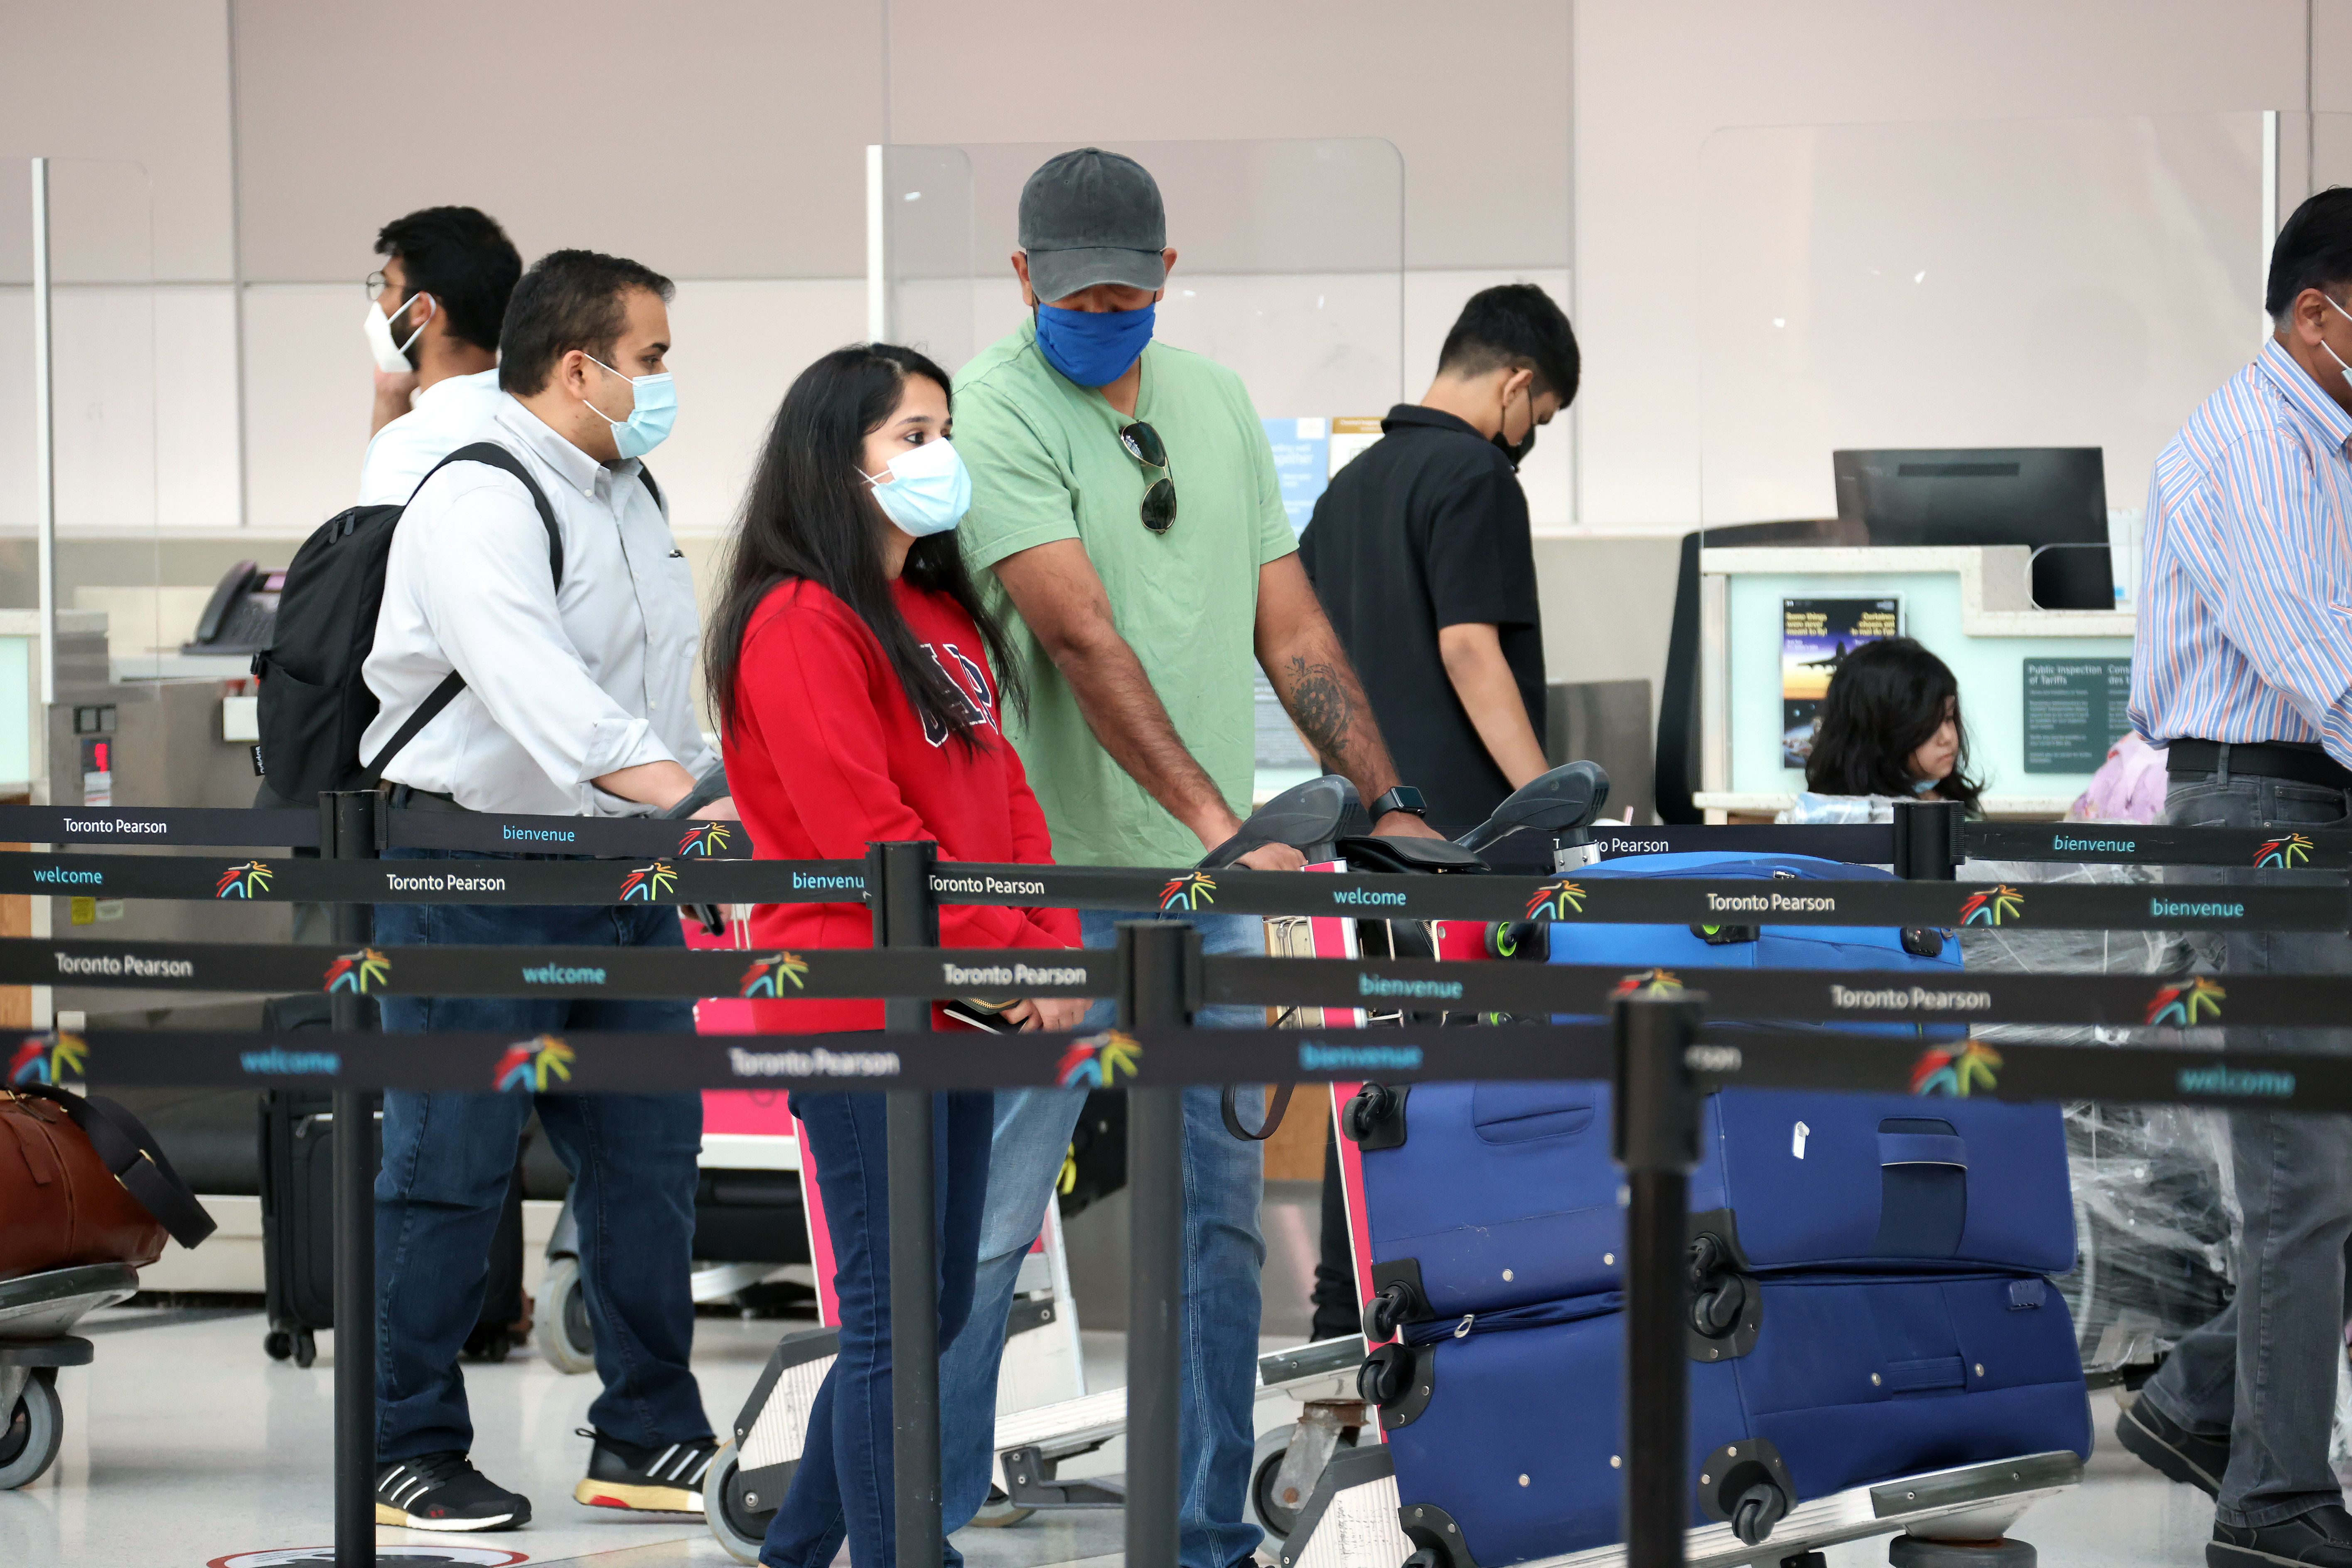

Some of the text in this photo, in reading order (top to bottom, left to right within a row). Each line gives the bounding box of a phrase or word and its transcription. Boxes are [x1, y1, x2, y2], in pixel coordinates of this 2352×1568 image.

[2029, 665, 2102, 675] Public Inspection
[2029, 675, 2067, 685] of Tariffs
[64, 818, 167, 833] Toronto Pearson
[504, 825, 575, 842] bienvenue
[1612, 838, 1669, 852] Pearson
[2054, 835, 2135, 852] bienvenue
[34, 866, 103, 884] welcome
[386, 874, 505, 890] Toronto Pearson
[793, 872, 864, 889] bienvenu
[929, 875, 1044, 894] Toronto Pearson
[1334, 887, 1406, 905] welcome
[1707, 893, 1835, 911] Toronto Pearson
[2151, 898, 2244, 917] bienvenue
[55, 953, 193, 976] Toronto Pearson
[523, 963, 606, 984] welcome
[943, 963, 1086, 985] Toronto Pearson
[1359, 974, 1463, 998] bienvenue
[1831, 985, 1991, 1009] Toronto Pearson
[241, 1049, 340, 1074] welcome
[730, 1047, 900, 1076] Toronto Pearson
[1299, 1043, 1423, 1069] bienvenue
[2180, 1067, 2295, 1094] welcome
